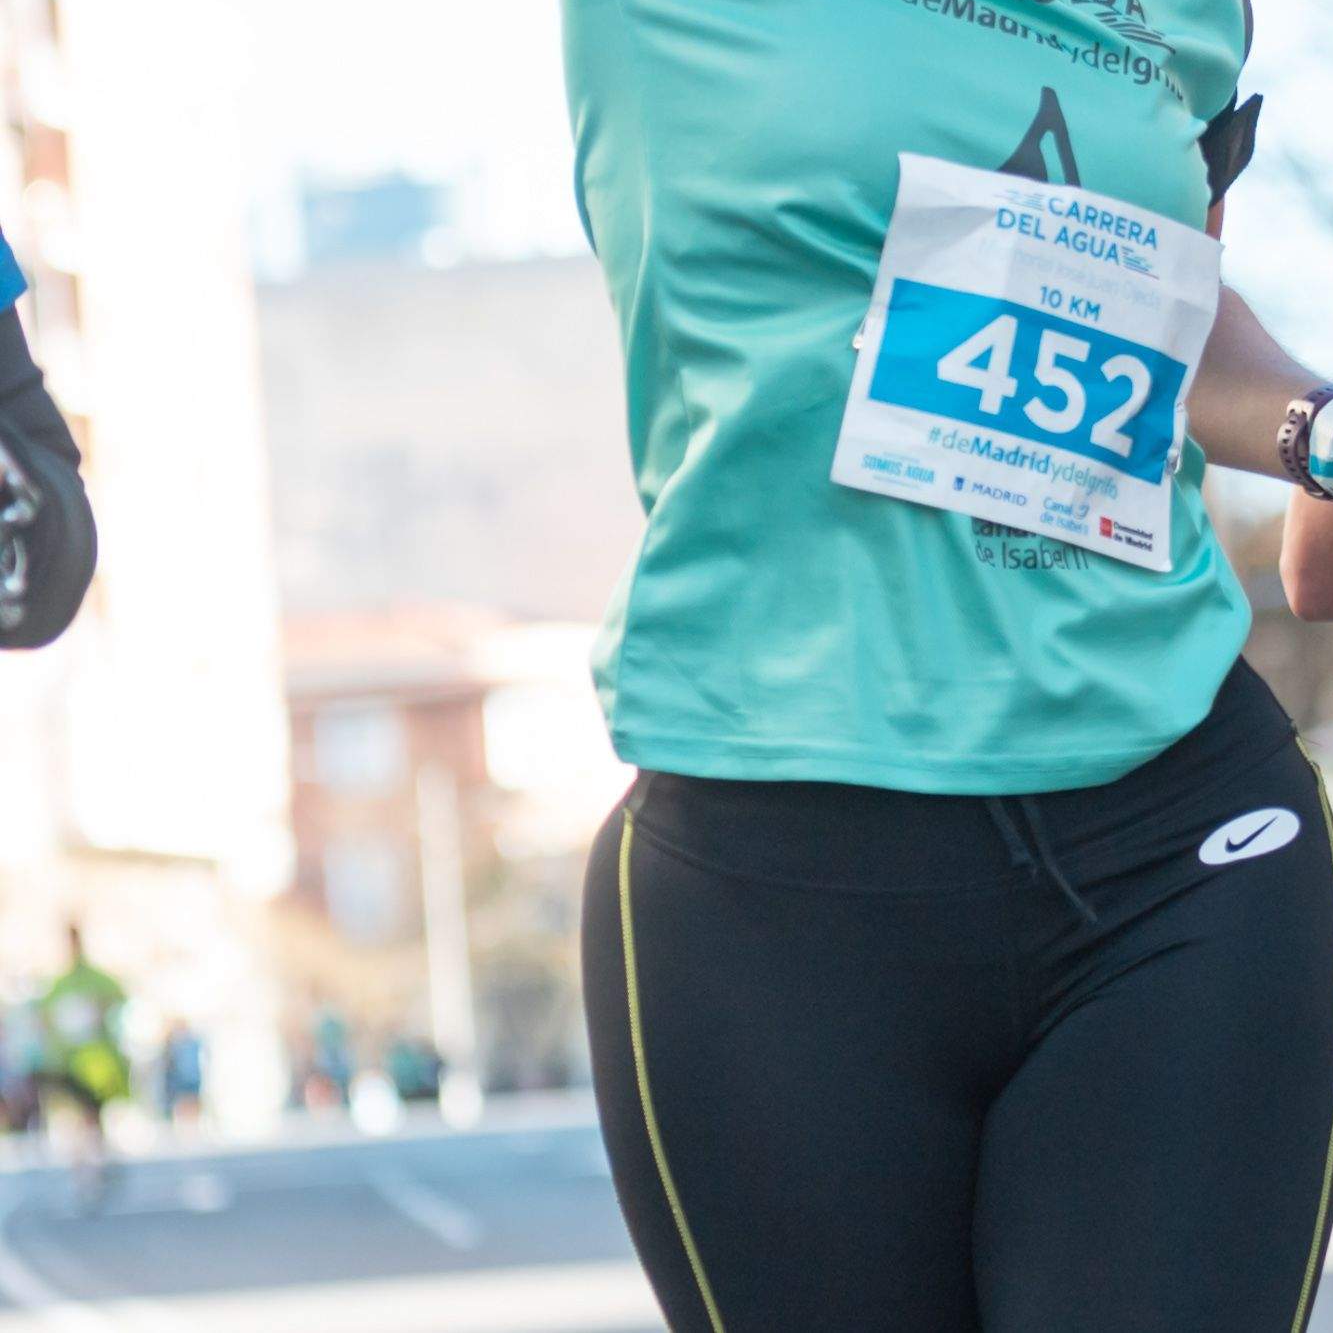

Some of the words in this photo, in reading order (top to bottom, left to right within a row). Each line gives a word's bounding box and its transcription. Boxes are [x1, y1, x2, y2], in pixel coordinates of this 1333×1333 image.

[995, 208, 1046, 241] DEL
[1053, 225, 1121, 266] AGUA
[1047, 197, 1158, 250] CARRERA
[1039, 286, 1063, 309] 10
[1068, 295, 1102, 322] KM
[937, 313, 1153, 459] 452
[972, 482, 1028, 507] MADRID
